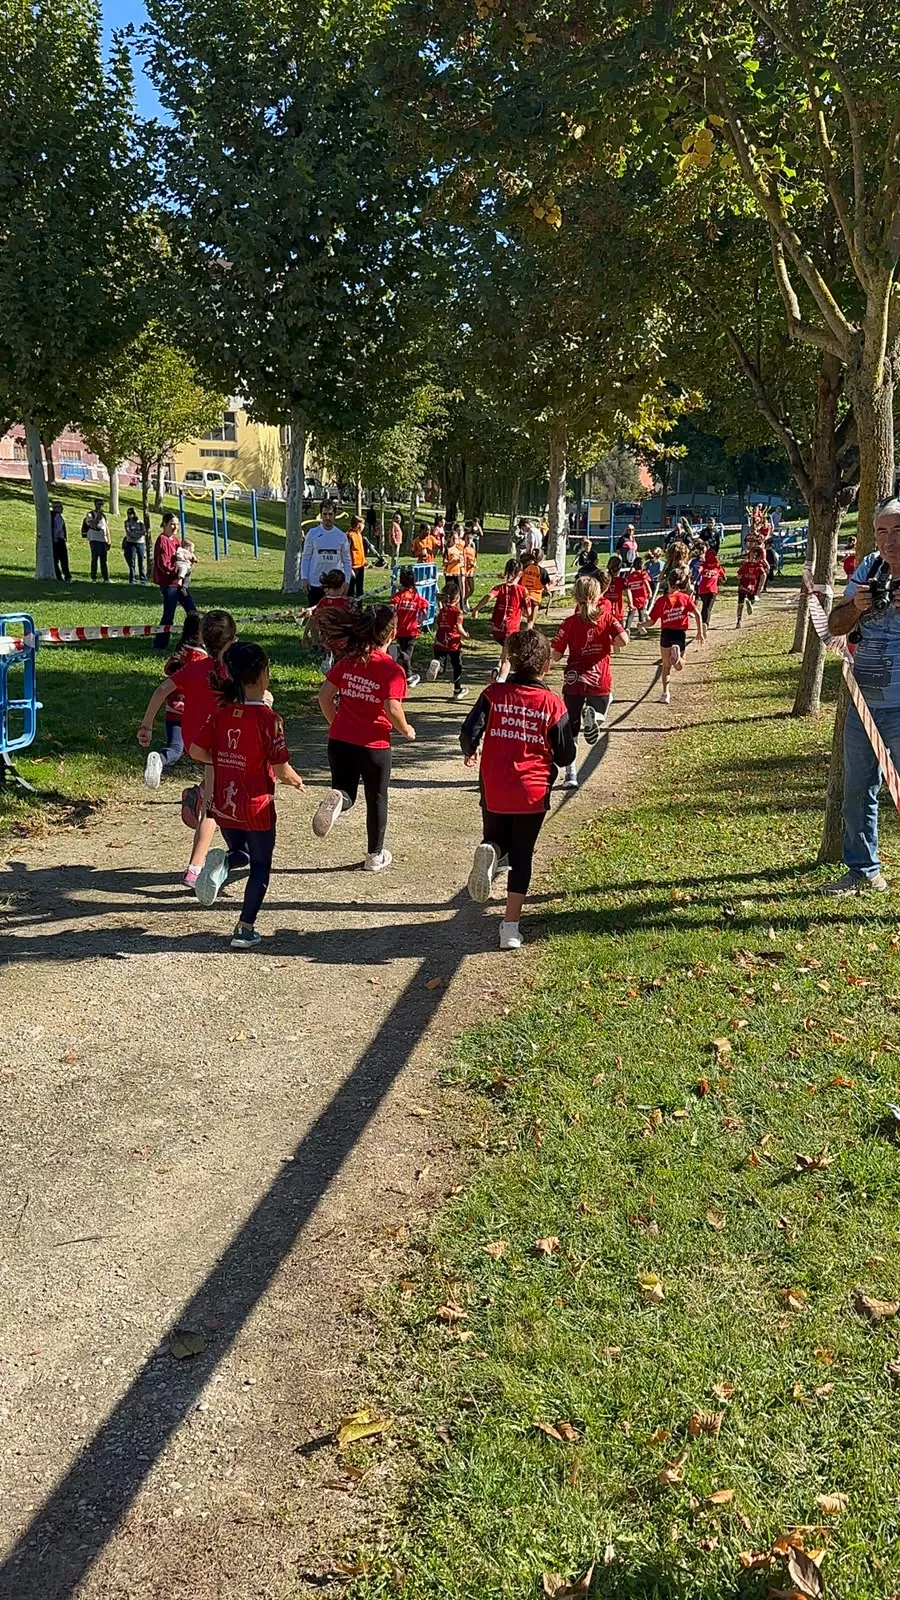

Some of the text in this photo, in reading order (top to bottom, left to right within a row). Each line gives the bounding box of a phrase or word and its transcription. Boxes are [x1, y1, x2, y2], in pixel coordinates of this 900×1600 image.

[342, 672, 381, 690] ATLETISMO
[347, 681, 372, 693] POMEZ
[501, 716, 538, 731] POMEZ
[490, 728, 545, 744] BARBASTRO
